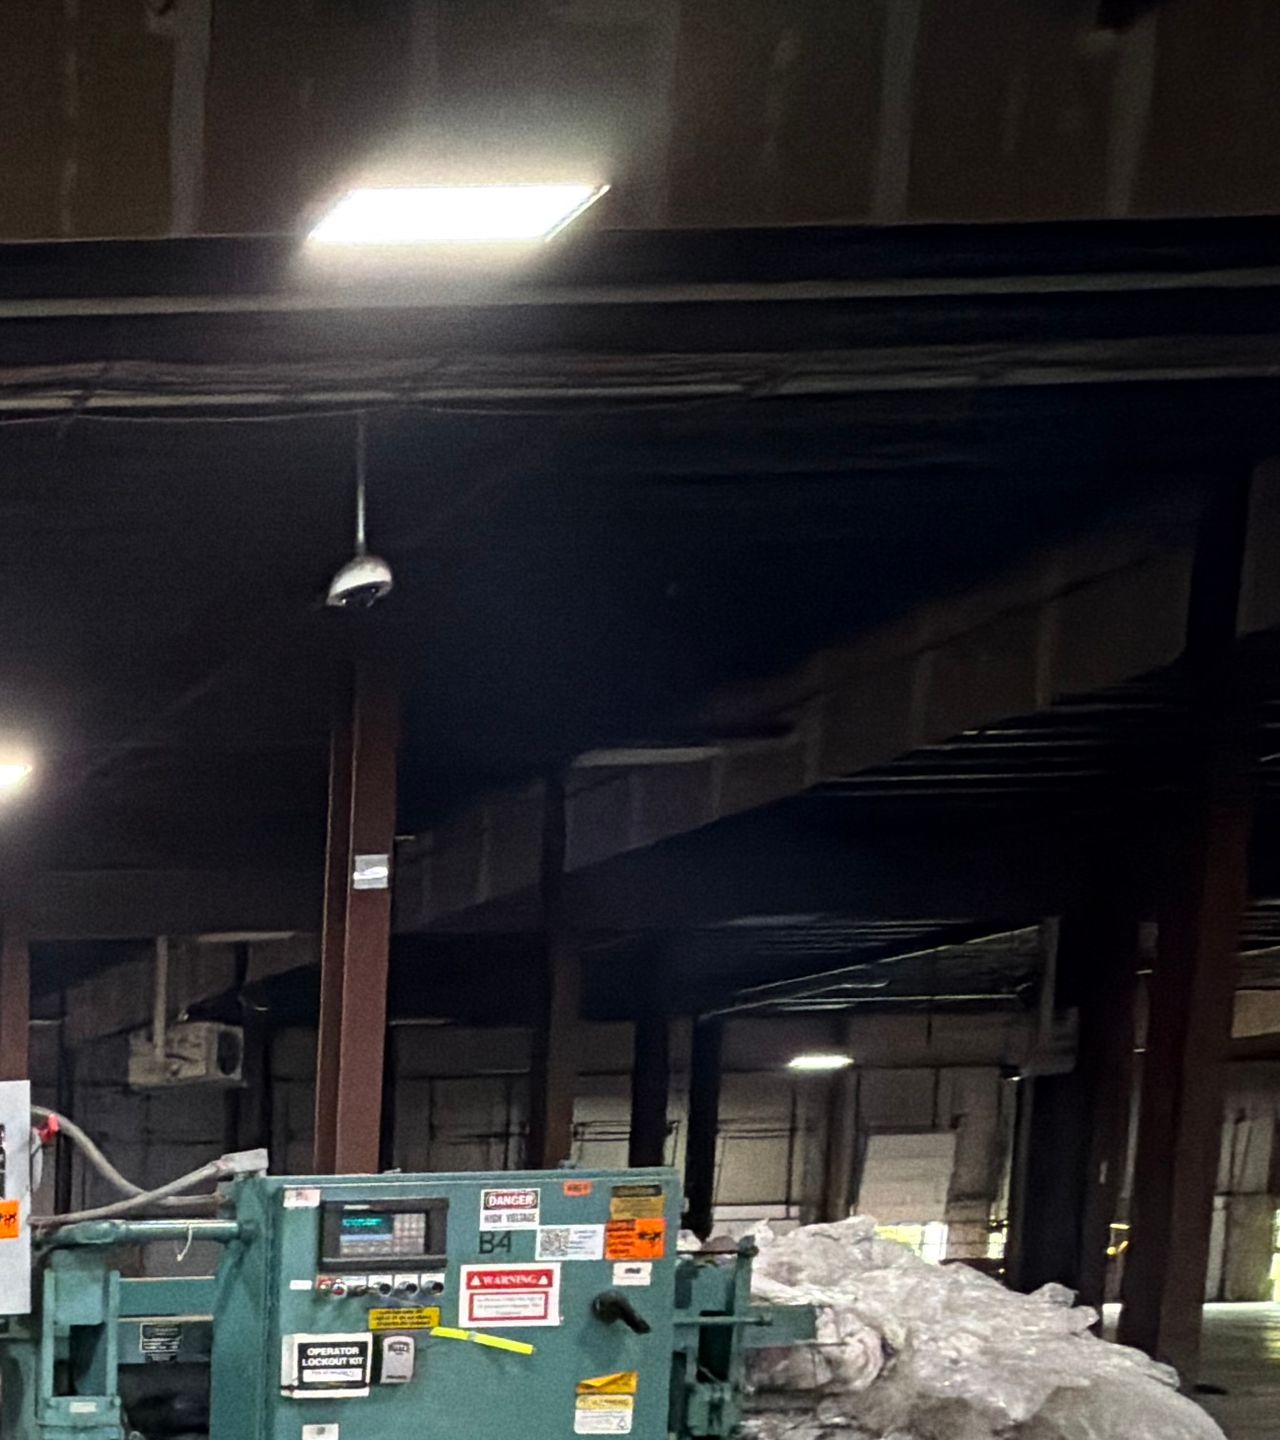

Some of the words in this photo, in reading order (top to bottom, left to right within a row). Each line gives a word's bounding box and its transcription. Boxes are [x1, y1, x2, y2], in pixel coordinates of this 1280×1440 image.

[488, 1194, 535, 1207] DANGER
[479, 1230, 512, 1255] B4
[482, 1274, 538, 1286] WARNING
[306, 1347, 360, 1356] OPERATOR
[302, 1358, 346, 1367] LOCKOUT
[348, 1357, 364, 1365] KIT
